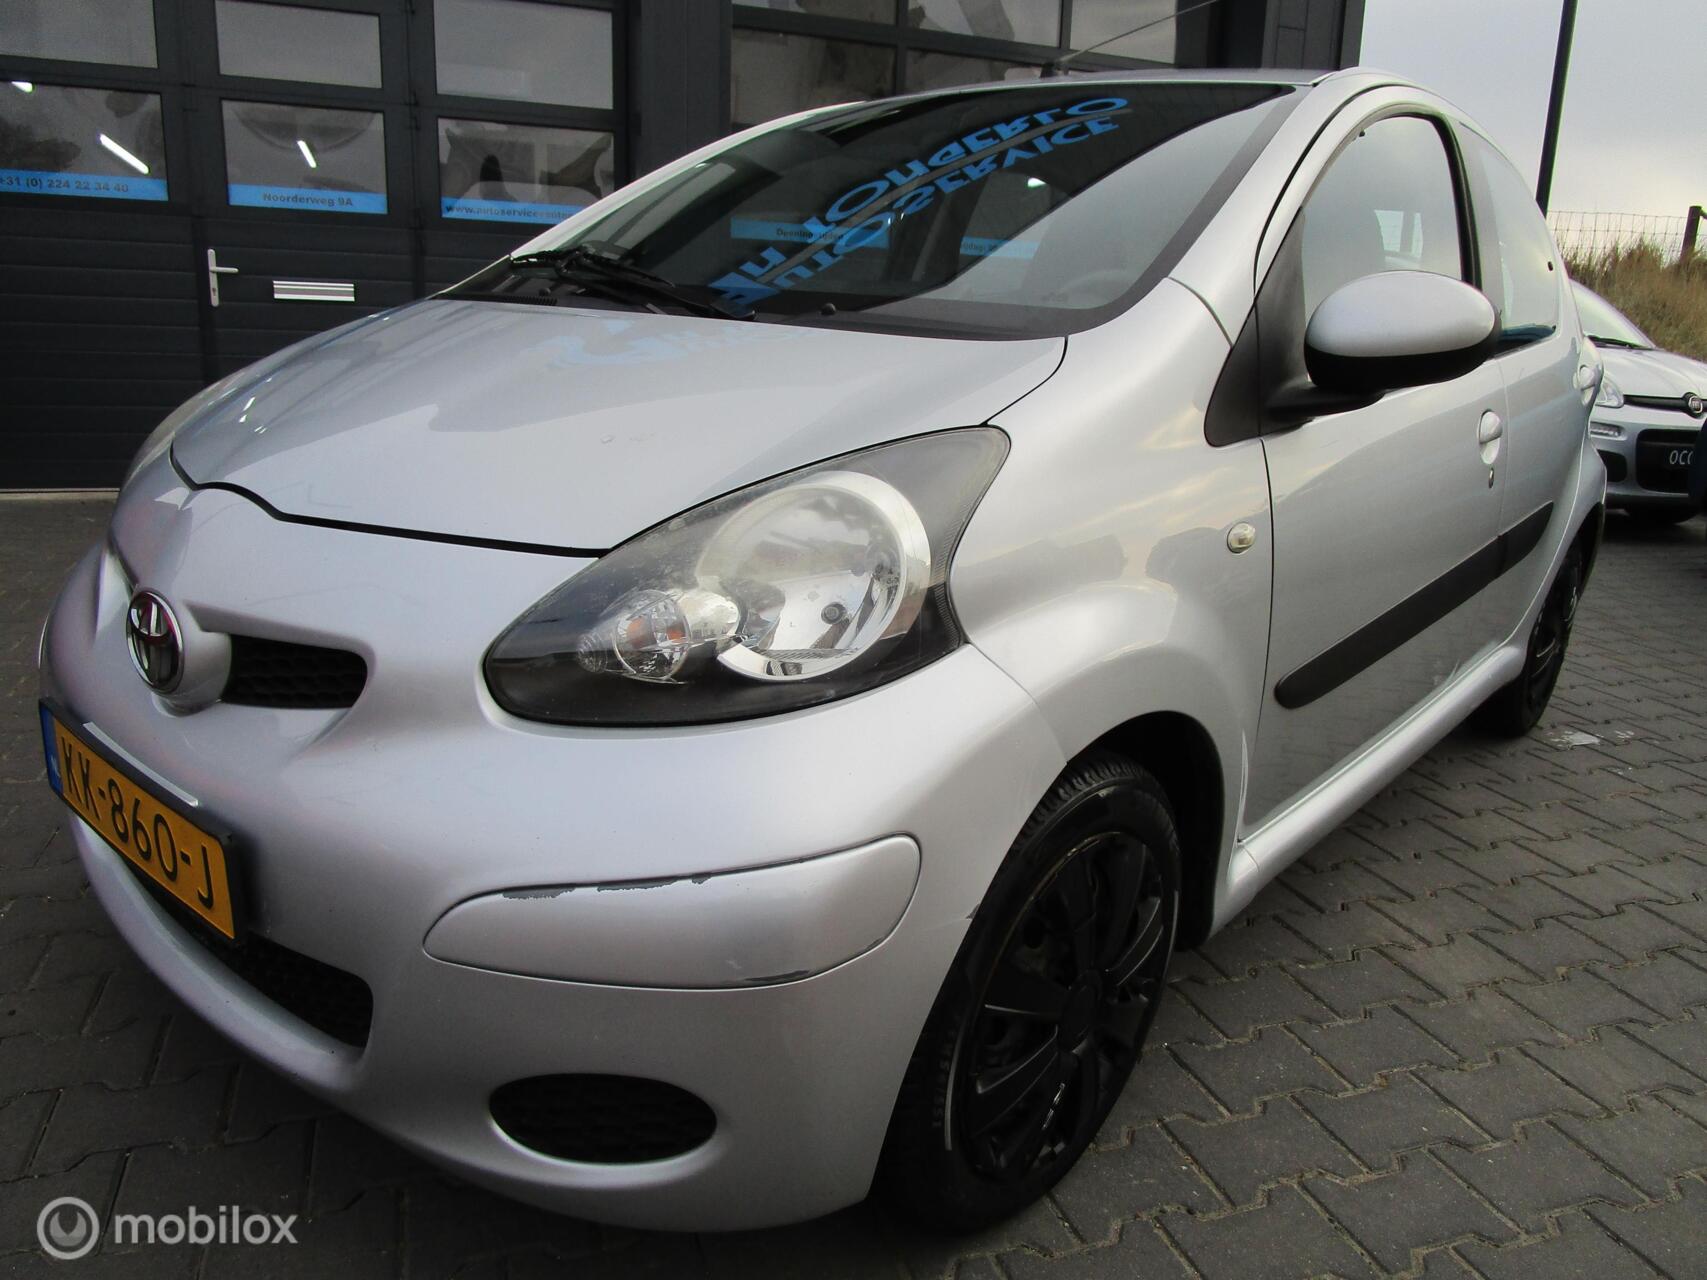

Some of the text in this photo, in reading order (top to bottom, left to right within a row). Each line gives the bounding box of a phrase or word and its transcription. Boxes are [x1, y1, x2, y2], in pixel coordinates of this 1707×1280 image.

[26, 177, 42, 190] (0)
[47, 179, 71, 189] 224
[75, 180, 91, 191] 22
[263, 192, 336, 207] Noorderweg
[61, 735, 215, 910] KK-860-J
